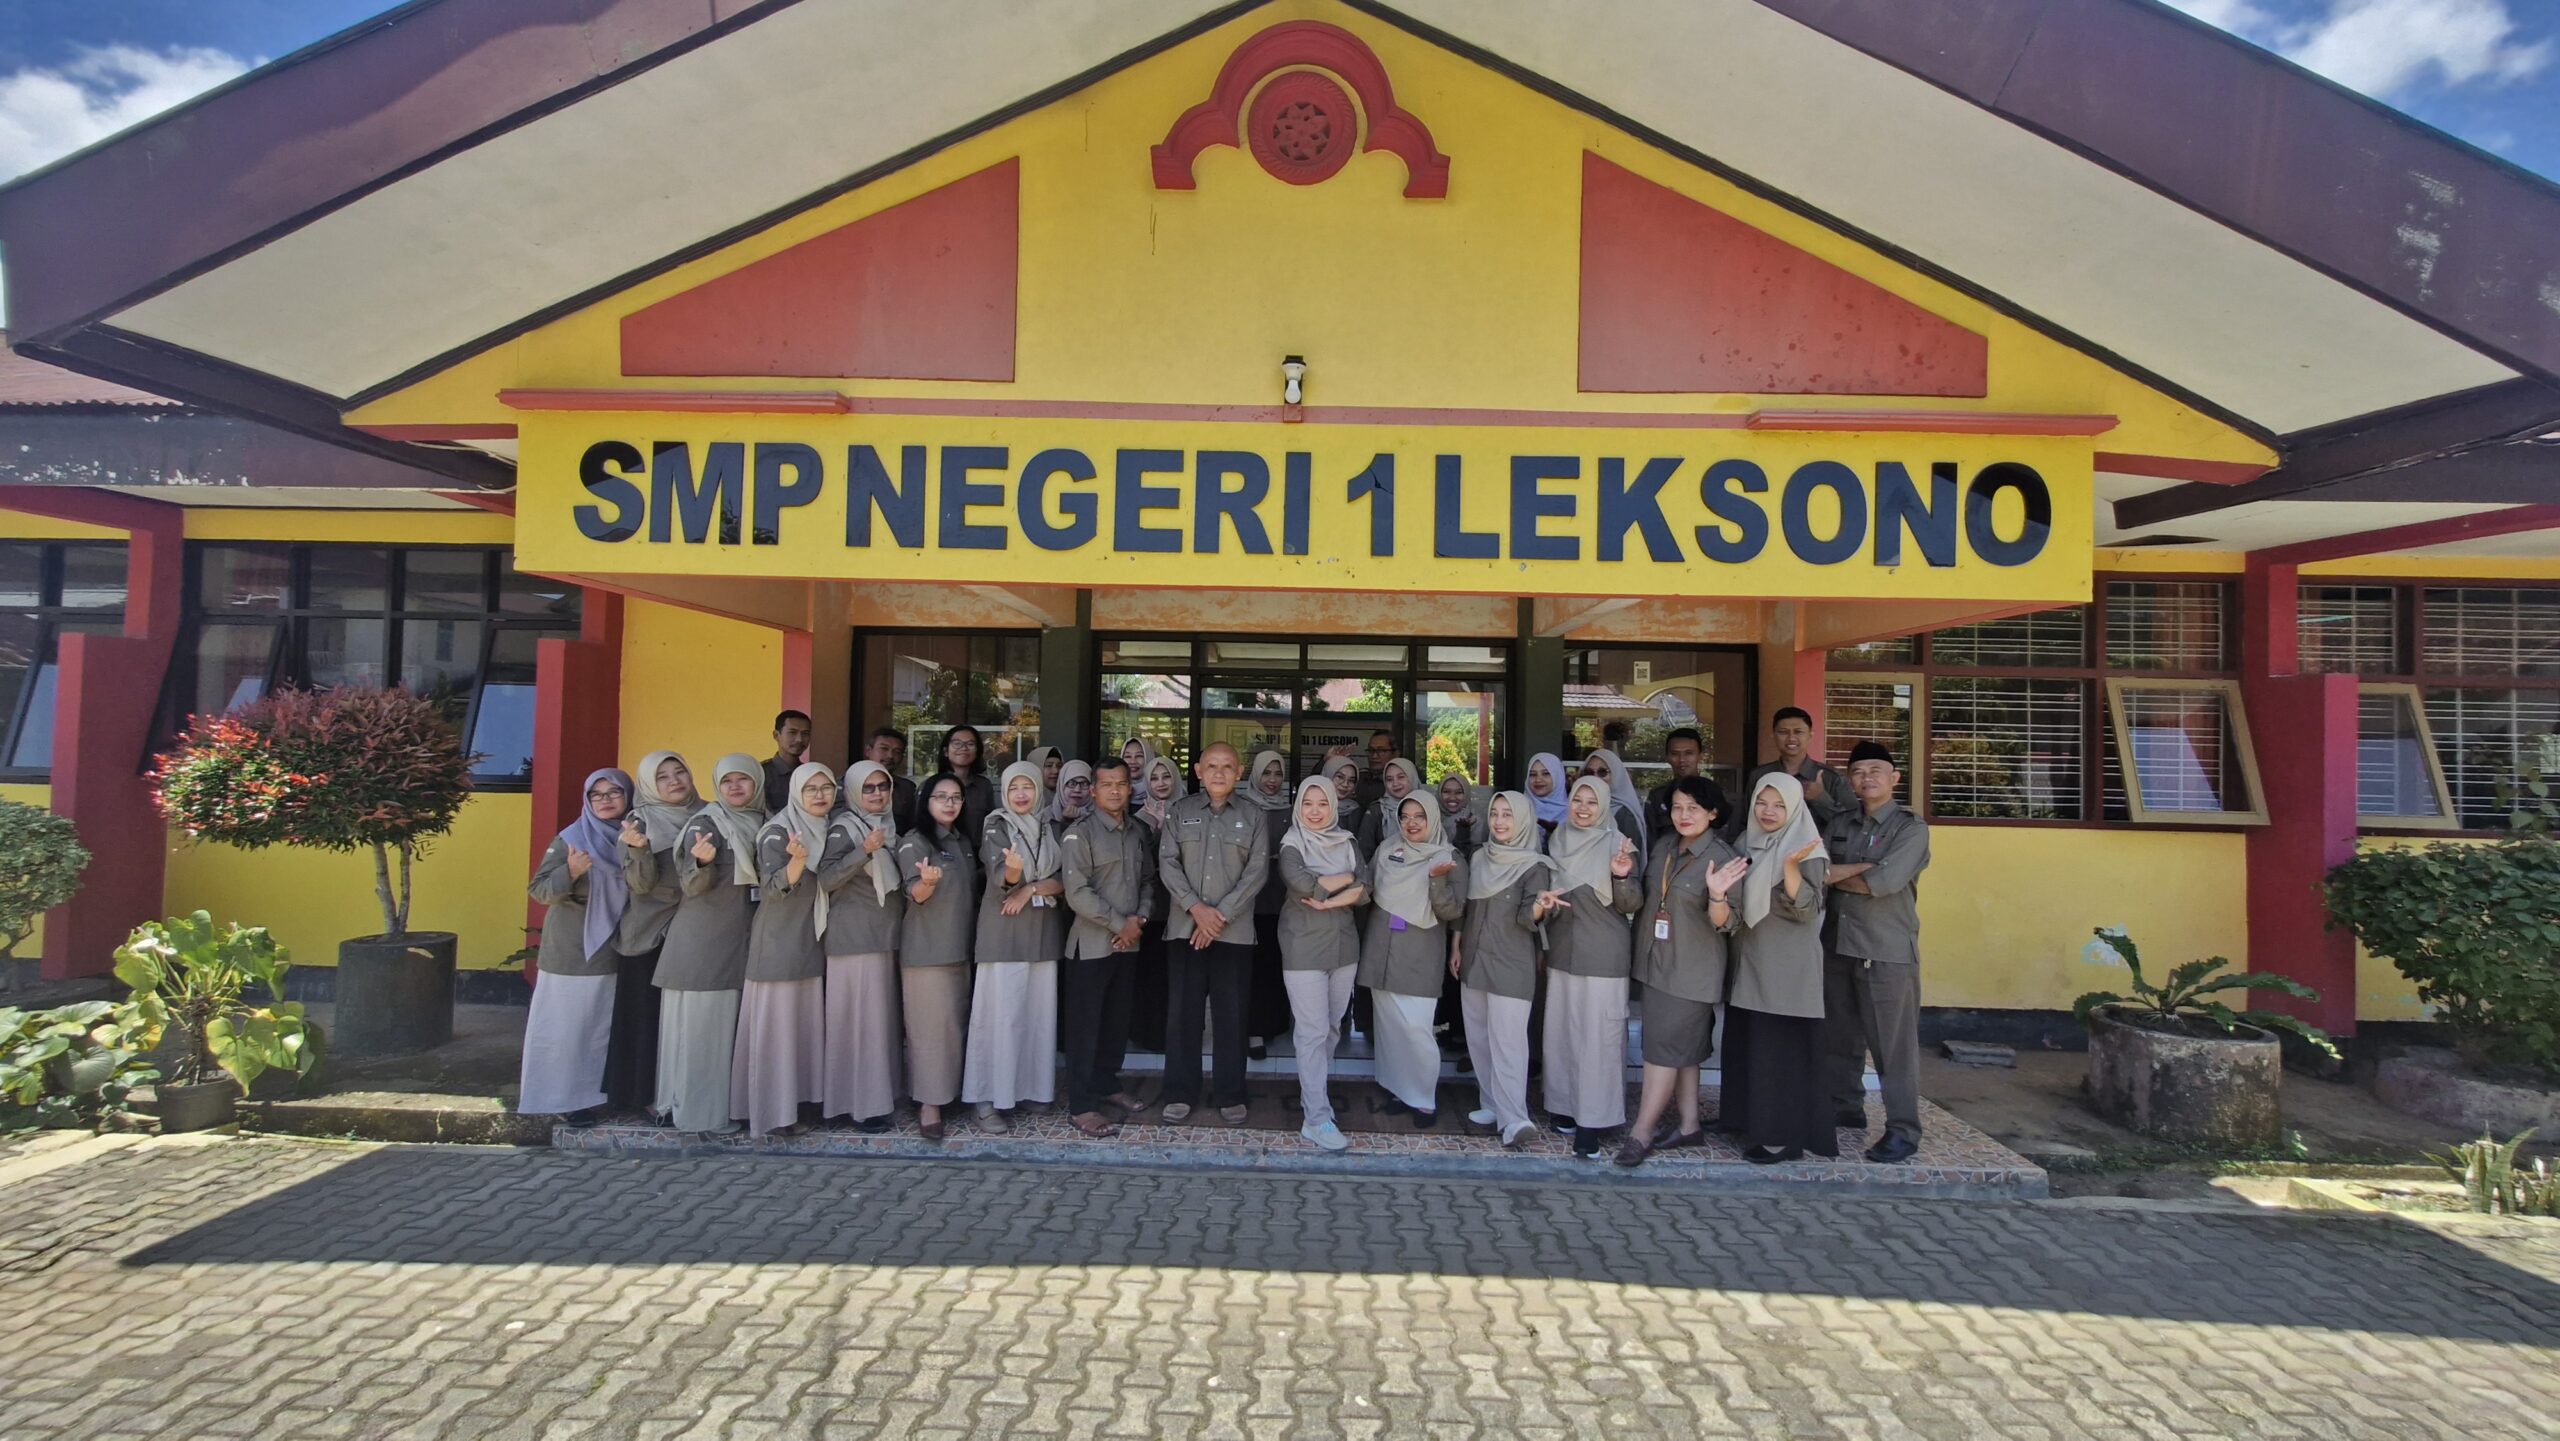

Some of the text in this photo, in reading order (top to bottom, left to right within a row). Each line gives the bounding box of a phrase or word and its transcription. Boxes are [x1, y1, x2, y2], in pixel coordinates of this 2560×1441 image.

[573, 441, 2052, 568] SMP NEGERI 1 LEKSONO
